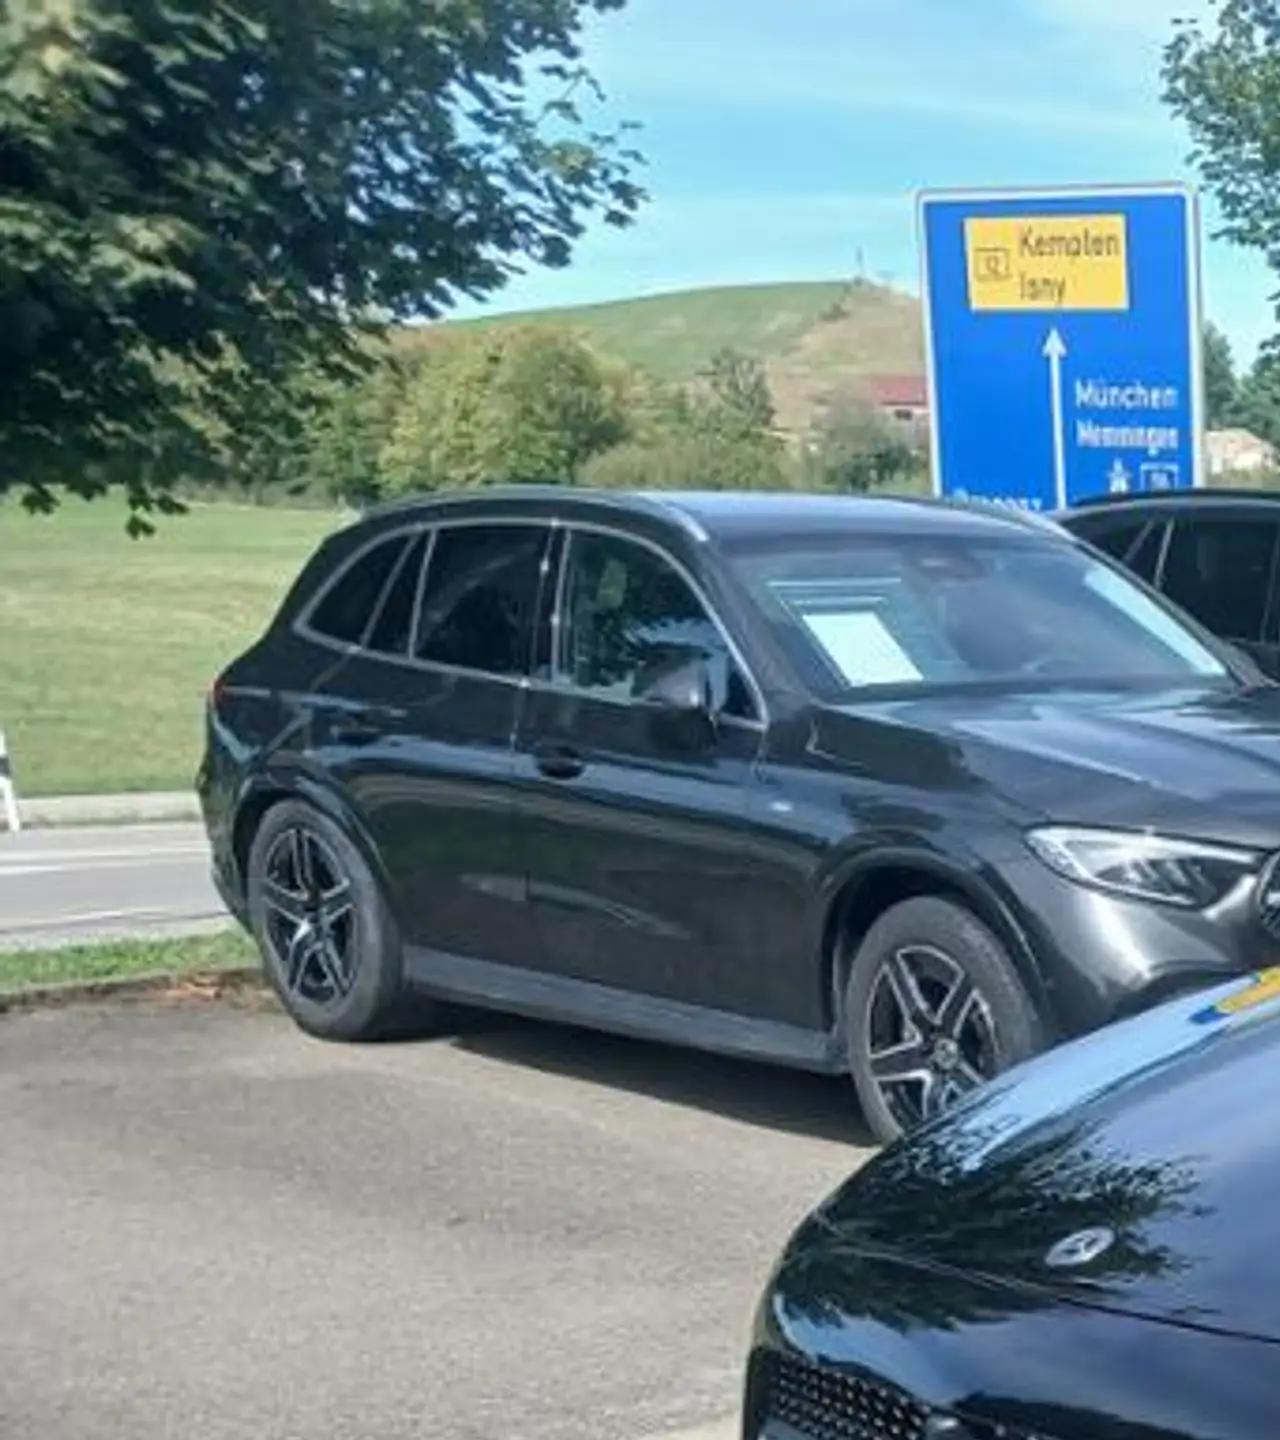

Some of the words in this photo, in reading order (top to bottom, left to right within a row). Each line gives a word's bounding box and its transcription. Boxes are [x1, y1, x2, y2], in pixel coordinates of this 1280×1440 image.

[1019, 225, 1119, 259] Kempten
[1018, 271, 1066, 304] Isny
[1074, 379, 1178, 409] München
[812, 710, 943, 808] Mercedes-Benz
[950, 776, 1008, 838] Junge
[1012, 804, 1086, 866] Sterne
